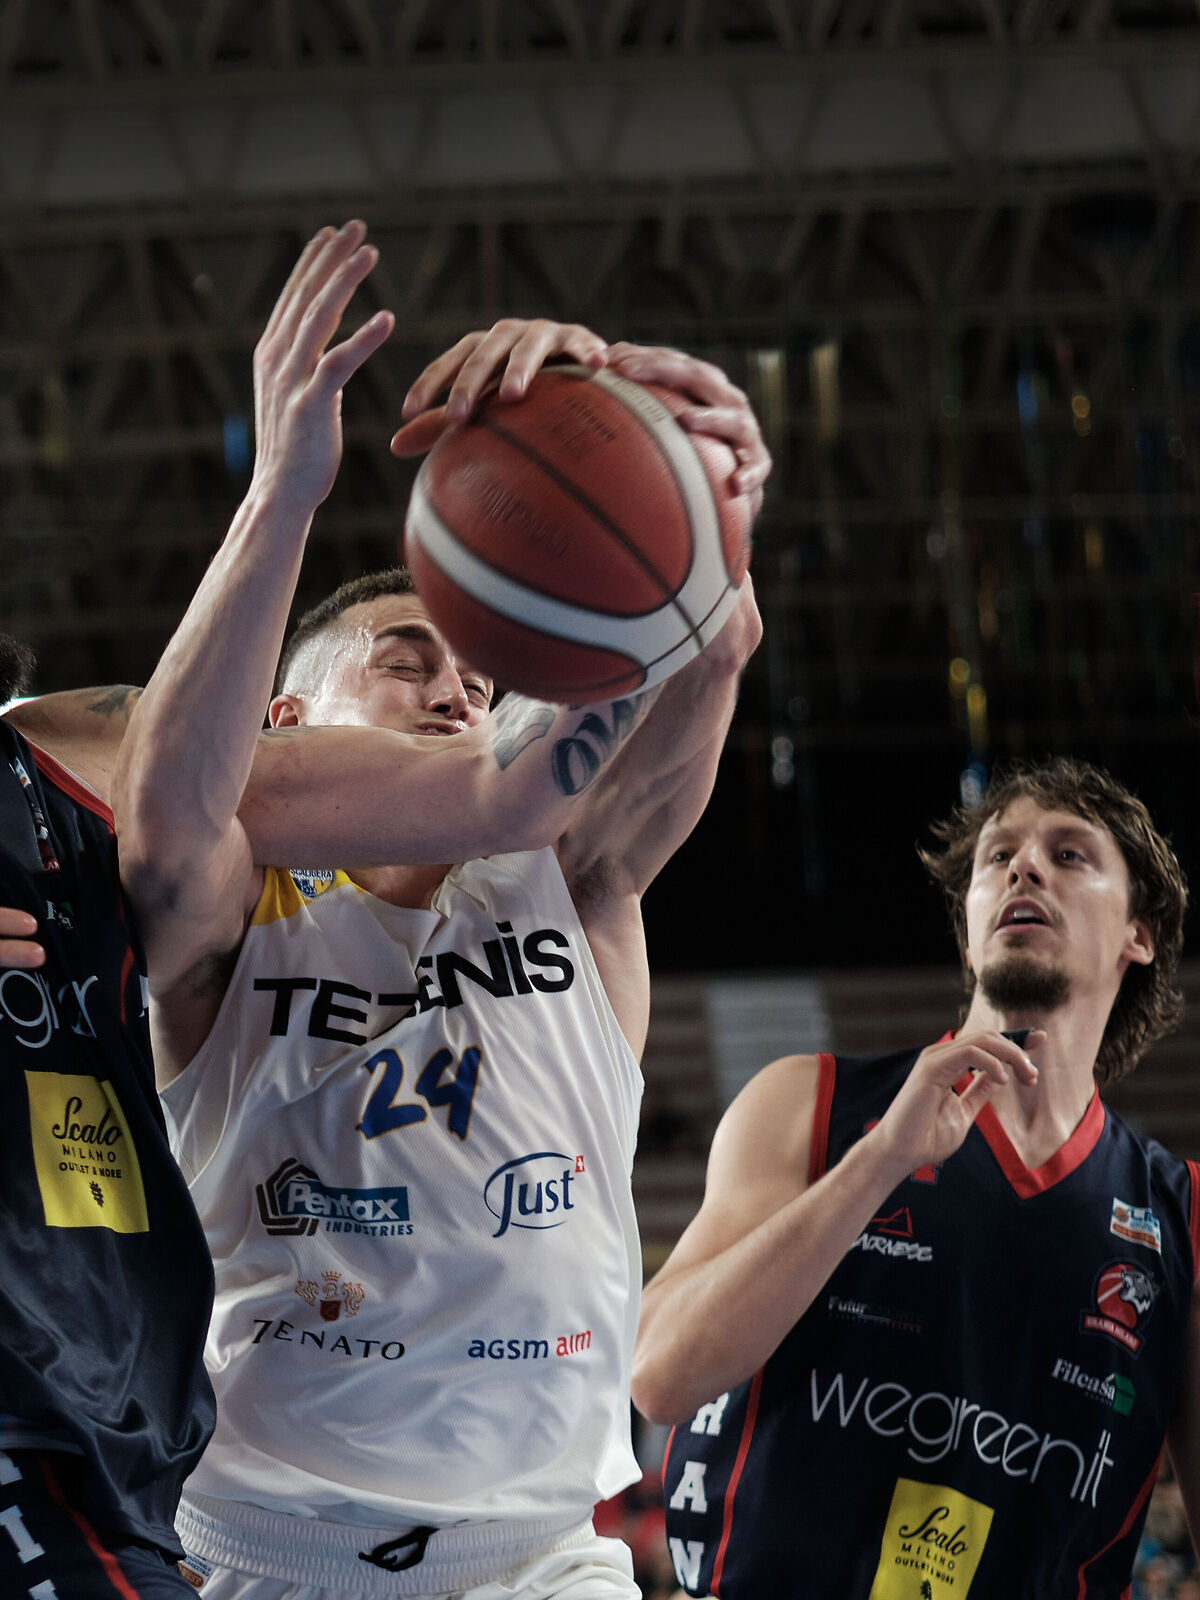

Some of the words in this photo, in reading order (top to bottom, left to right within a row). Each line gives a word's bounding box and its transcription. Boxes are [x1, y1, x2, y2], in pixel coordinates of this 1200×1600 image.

[355, 1044, 484, 1142] 24
[52, 1096, 123, 1146] Scalo
[287, 1182, 400, 1222] Pentax
[492, 1169, 575, 1239] Just
[326, 1221, 414, 1237] INDUSTRIES
[811, 1368, 1114, 1508] wegreenit
[899, 1506, 968, 1556] Scalo
